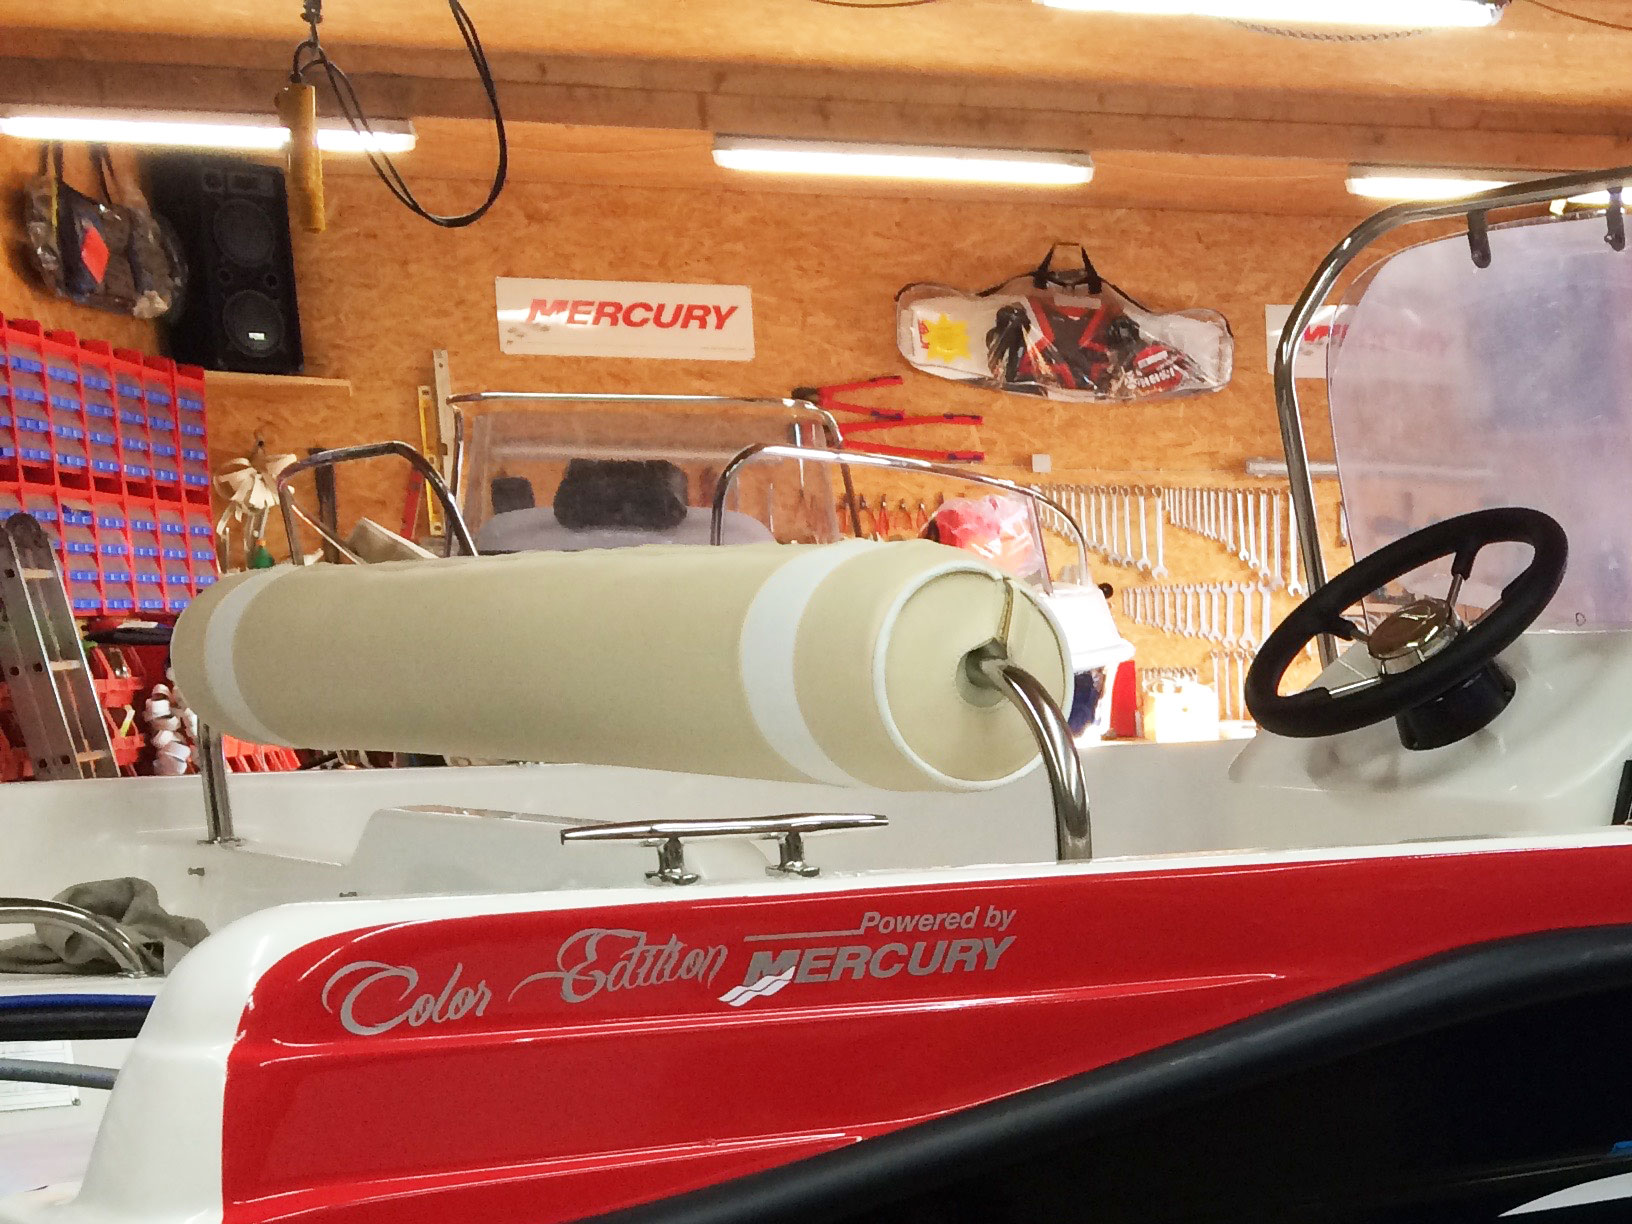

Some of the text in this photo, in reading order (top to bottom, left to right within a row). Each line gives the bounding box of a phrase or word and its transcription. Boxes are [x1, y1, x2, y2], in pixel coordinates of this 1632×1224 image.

[526, 299, 739, 331] MERCURY
[861, 905, 1017, 934] Powered by
[322, 928, 728, 1036] Color Edition
[742, 936, 1017, 987] MERCURY
